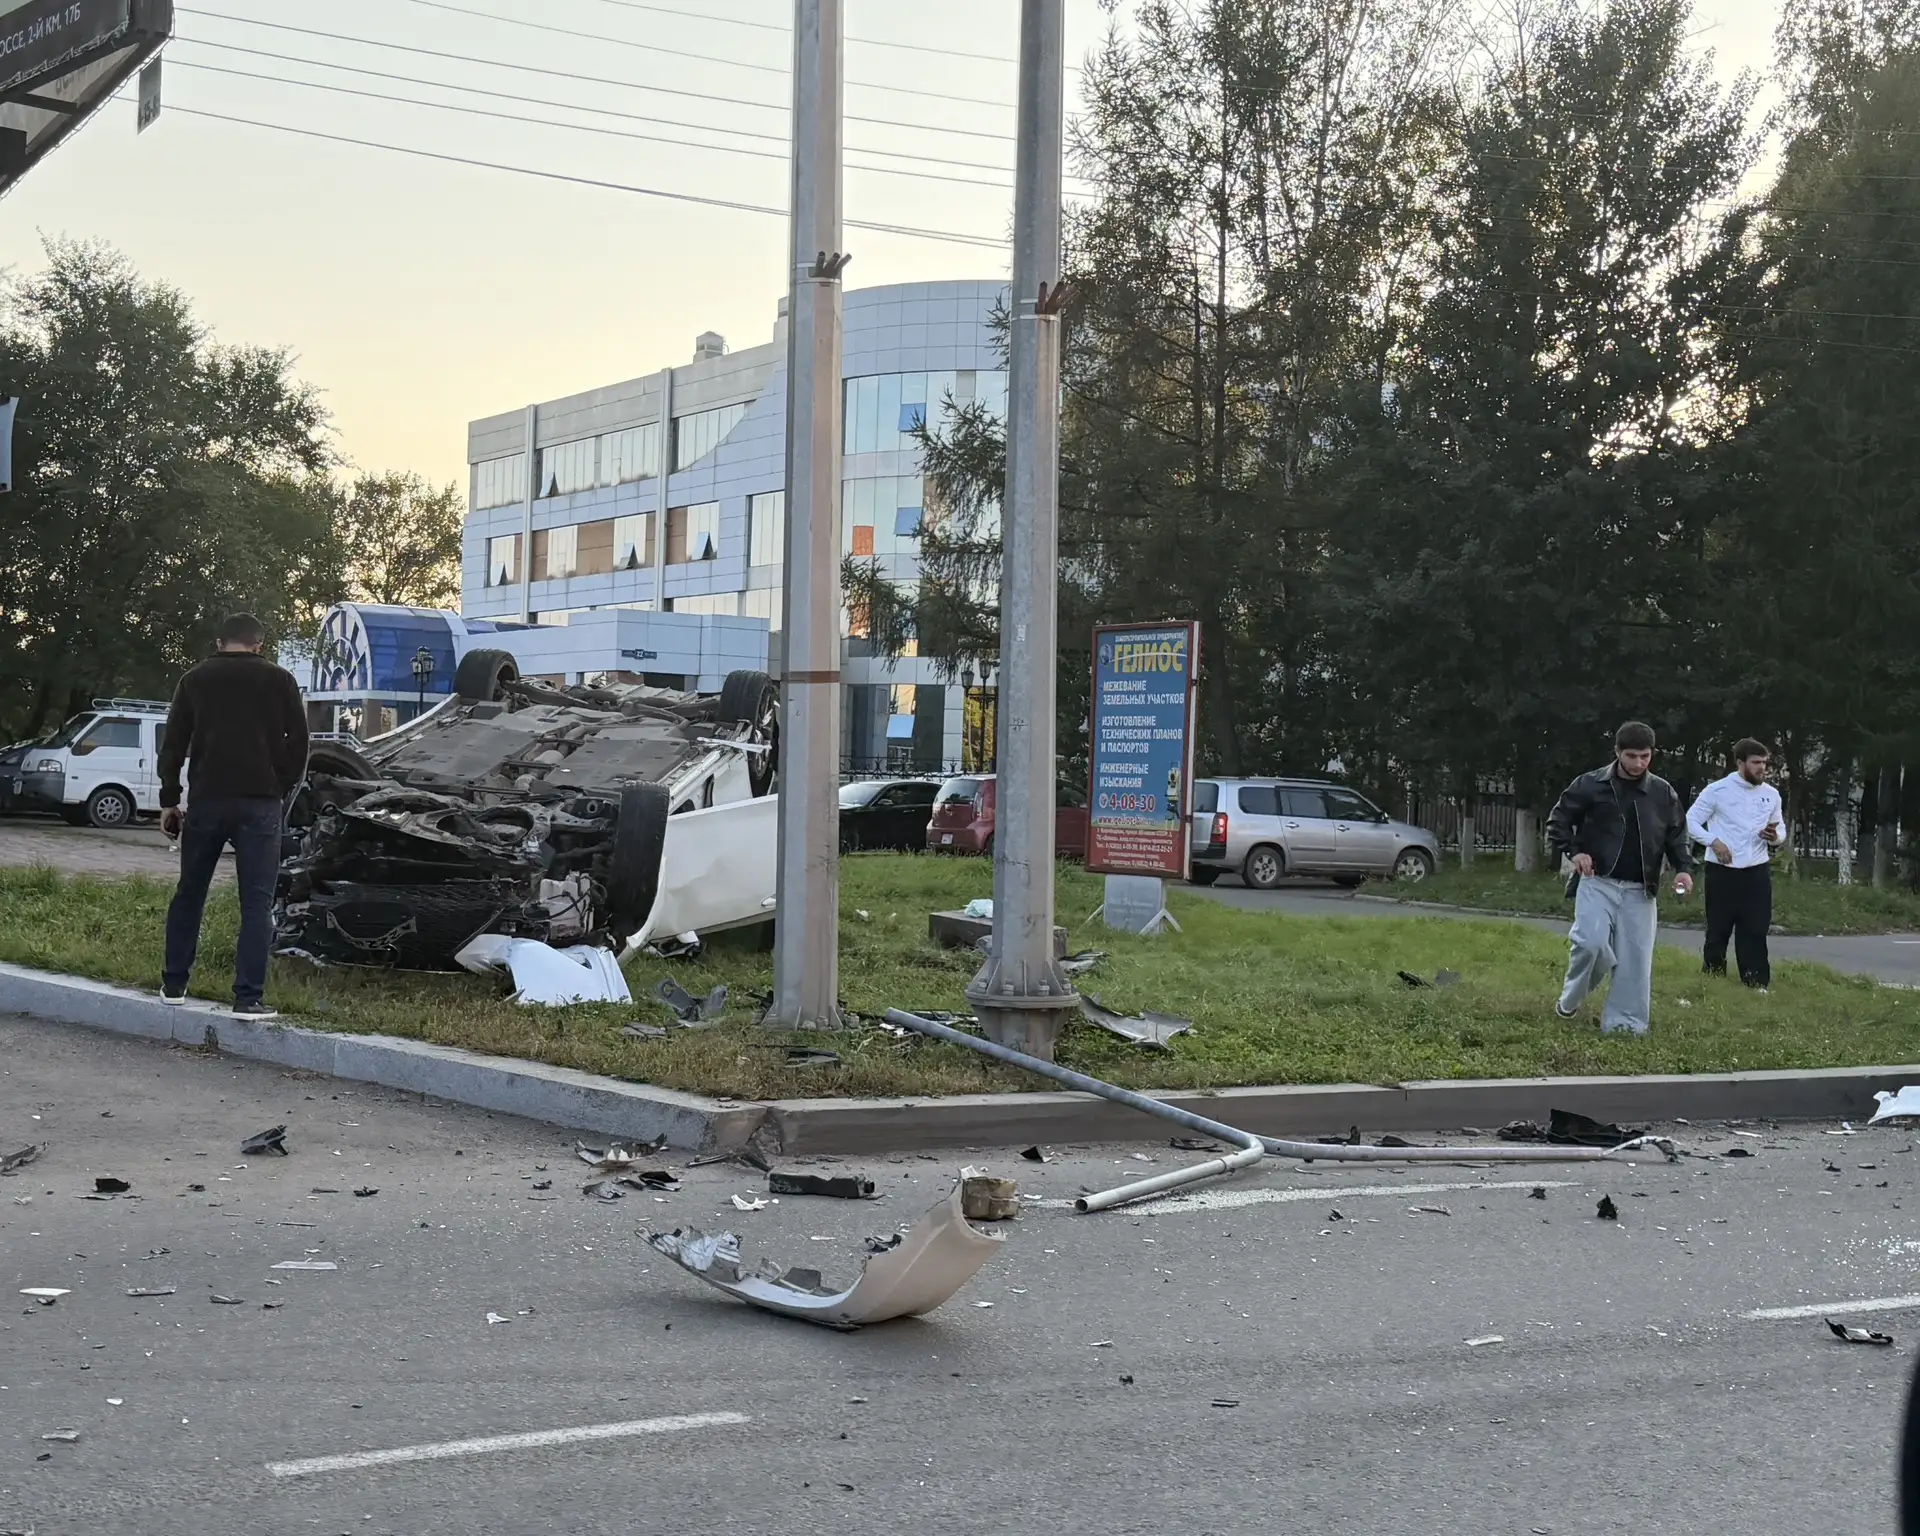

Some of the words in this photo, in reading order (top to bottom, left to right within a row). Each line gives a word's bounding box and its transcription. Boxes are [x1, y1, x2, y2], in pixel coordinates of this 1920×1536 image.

[28, 17, 44, 43] 2-Й
[46, 12, 62, 36] КМ,
[65, 2, 81, 25] 17Б
[1114, 641, 1184, 673] ГЕЛИОС
[1103, 680, 1147, 692] МЕЖЕВАНИЕ
[1102, 694, 1146, 705] ЗЕМЕЛЬНЫХ
[1147, 693, 1185, 704] УЧАСТКОВ
[1101, 716, 1156, 727] ИЗГОТОВЛЕНИЕ
[1101, 729, 1152, 740] ТЕХНИЧЕСКИХ
[1153, 728, 1183, 740] ПЛАНОВ
[1101, 742, 1106, 753] И
[1107, 742, 1149, 753] ПАСПОРТОВ
[1100, 762, 1149, 774] ИНЖЕНЕРНЫЕ
[1099, 777, 1142, 788] ИЗЫСКАНИЯ
[1109, 793, 1156, 812] 4-08-30
